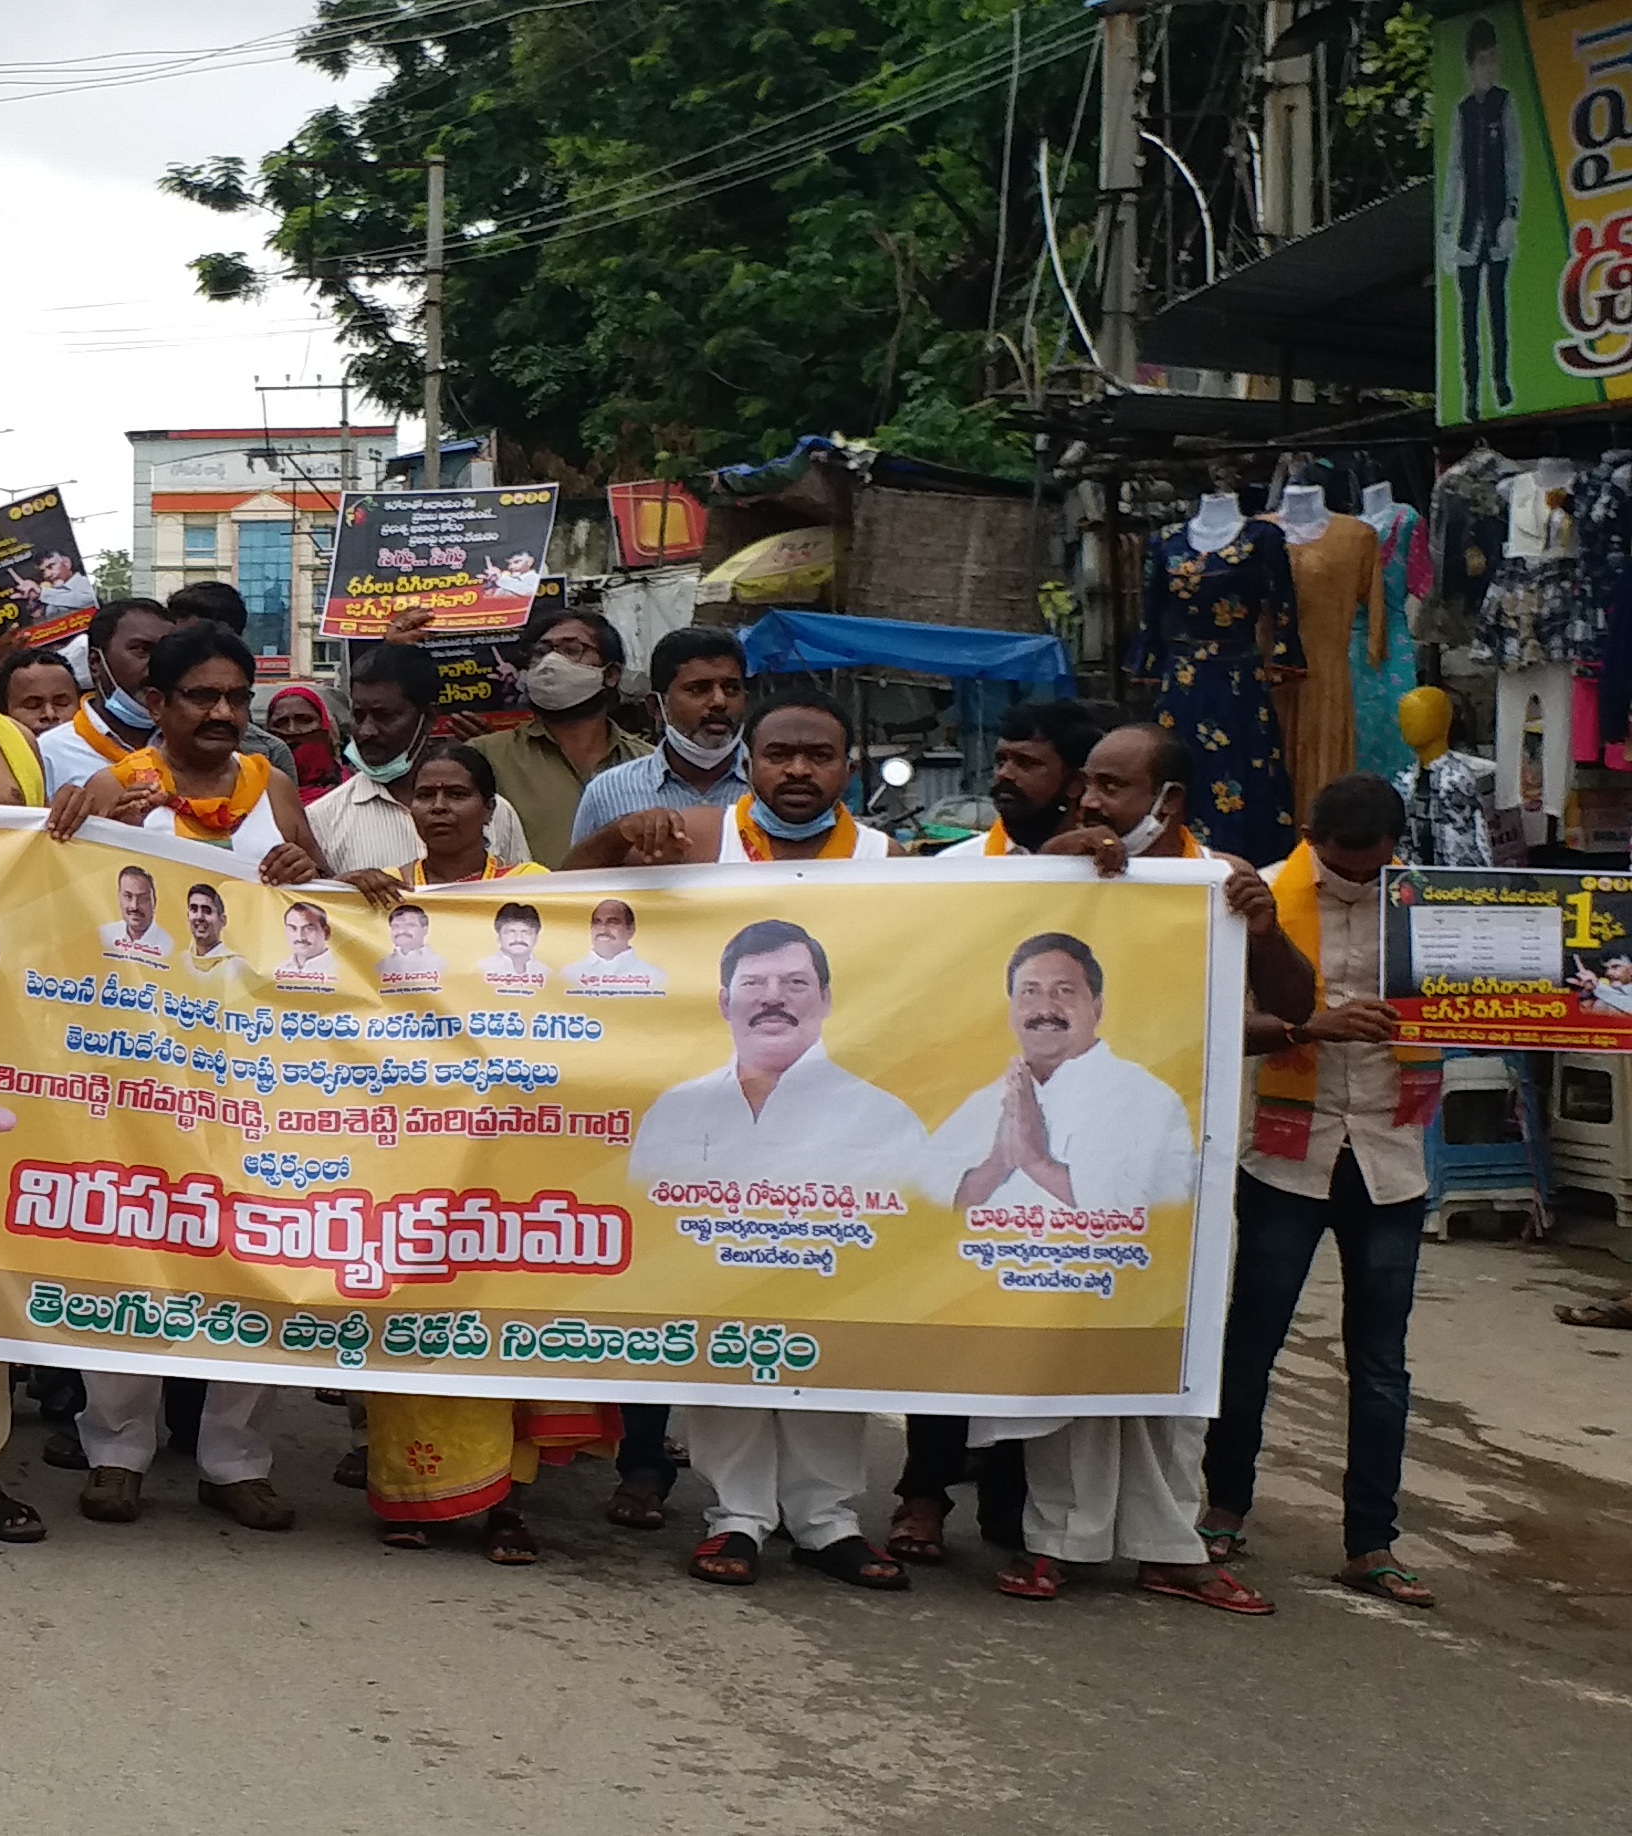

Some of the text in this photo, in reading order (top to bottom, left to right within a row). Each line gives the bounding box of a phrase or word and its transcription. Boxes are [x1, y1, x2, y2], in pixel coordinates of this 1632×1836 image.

[347, 575, 394, 597] ధరలు
[345, 591, 478, 619] జగన్ దిగిపోవాలి
[438, 682, 492, 705] పోవాలి
[1565, 891, 1601, 948] 1
[1421, 975, 1469, 998] ధరలు
[27, 972, 601, 1042] పెంచిన డీజల్, పెట్రోల్, గ్యాస్ ధరలకు నిరసనగా కడప నగరం
[1421, 996, 1567, 1021] జగన్ దిగిపోవాలి
[67, 1027, 557, 1094] తెలుగుదేశం పార్టీ రాష్ట్ర కార్యనిర్వాహక కార్యదర్శులు
[117, 1080, 215, 1127] గోవర్ధన్
[221, 1098, 269, 1141] రెడ్డి,
[279, 1107, 397, 1145] బాలిశెట్టి
[407, 1106, 561, 1136] హరిప్రసాద్
[569, 1111, 629, 1143] గార్ల
[650, 1182, 904, 1218] శింగారెడ్డి గోవర్ధన్ రెడ్డి, M.A.
[14, 1166, 622, 1290] నిరసన కార్యక్రమము
[970, 1206, 1147, 1238] బాలిశెట్టి హరిప్రసాద్
[721, 1246, 832, 1272] తెలుగుదేశం పార్టీ
[1004, 1270, 1111, 1295] తెలుగుదేశం పార్టీ
[30, 1286, 816, 1379] తెలుగుదేశం పార్టీ కడప నియోజక వర్గం
